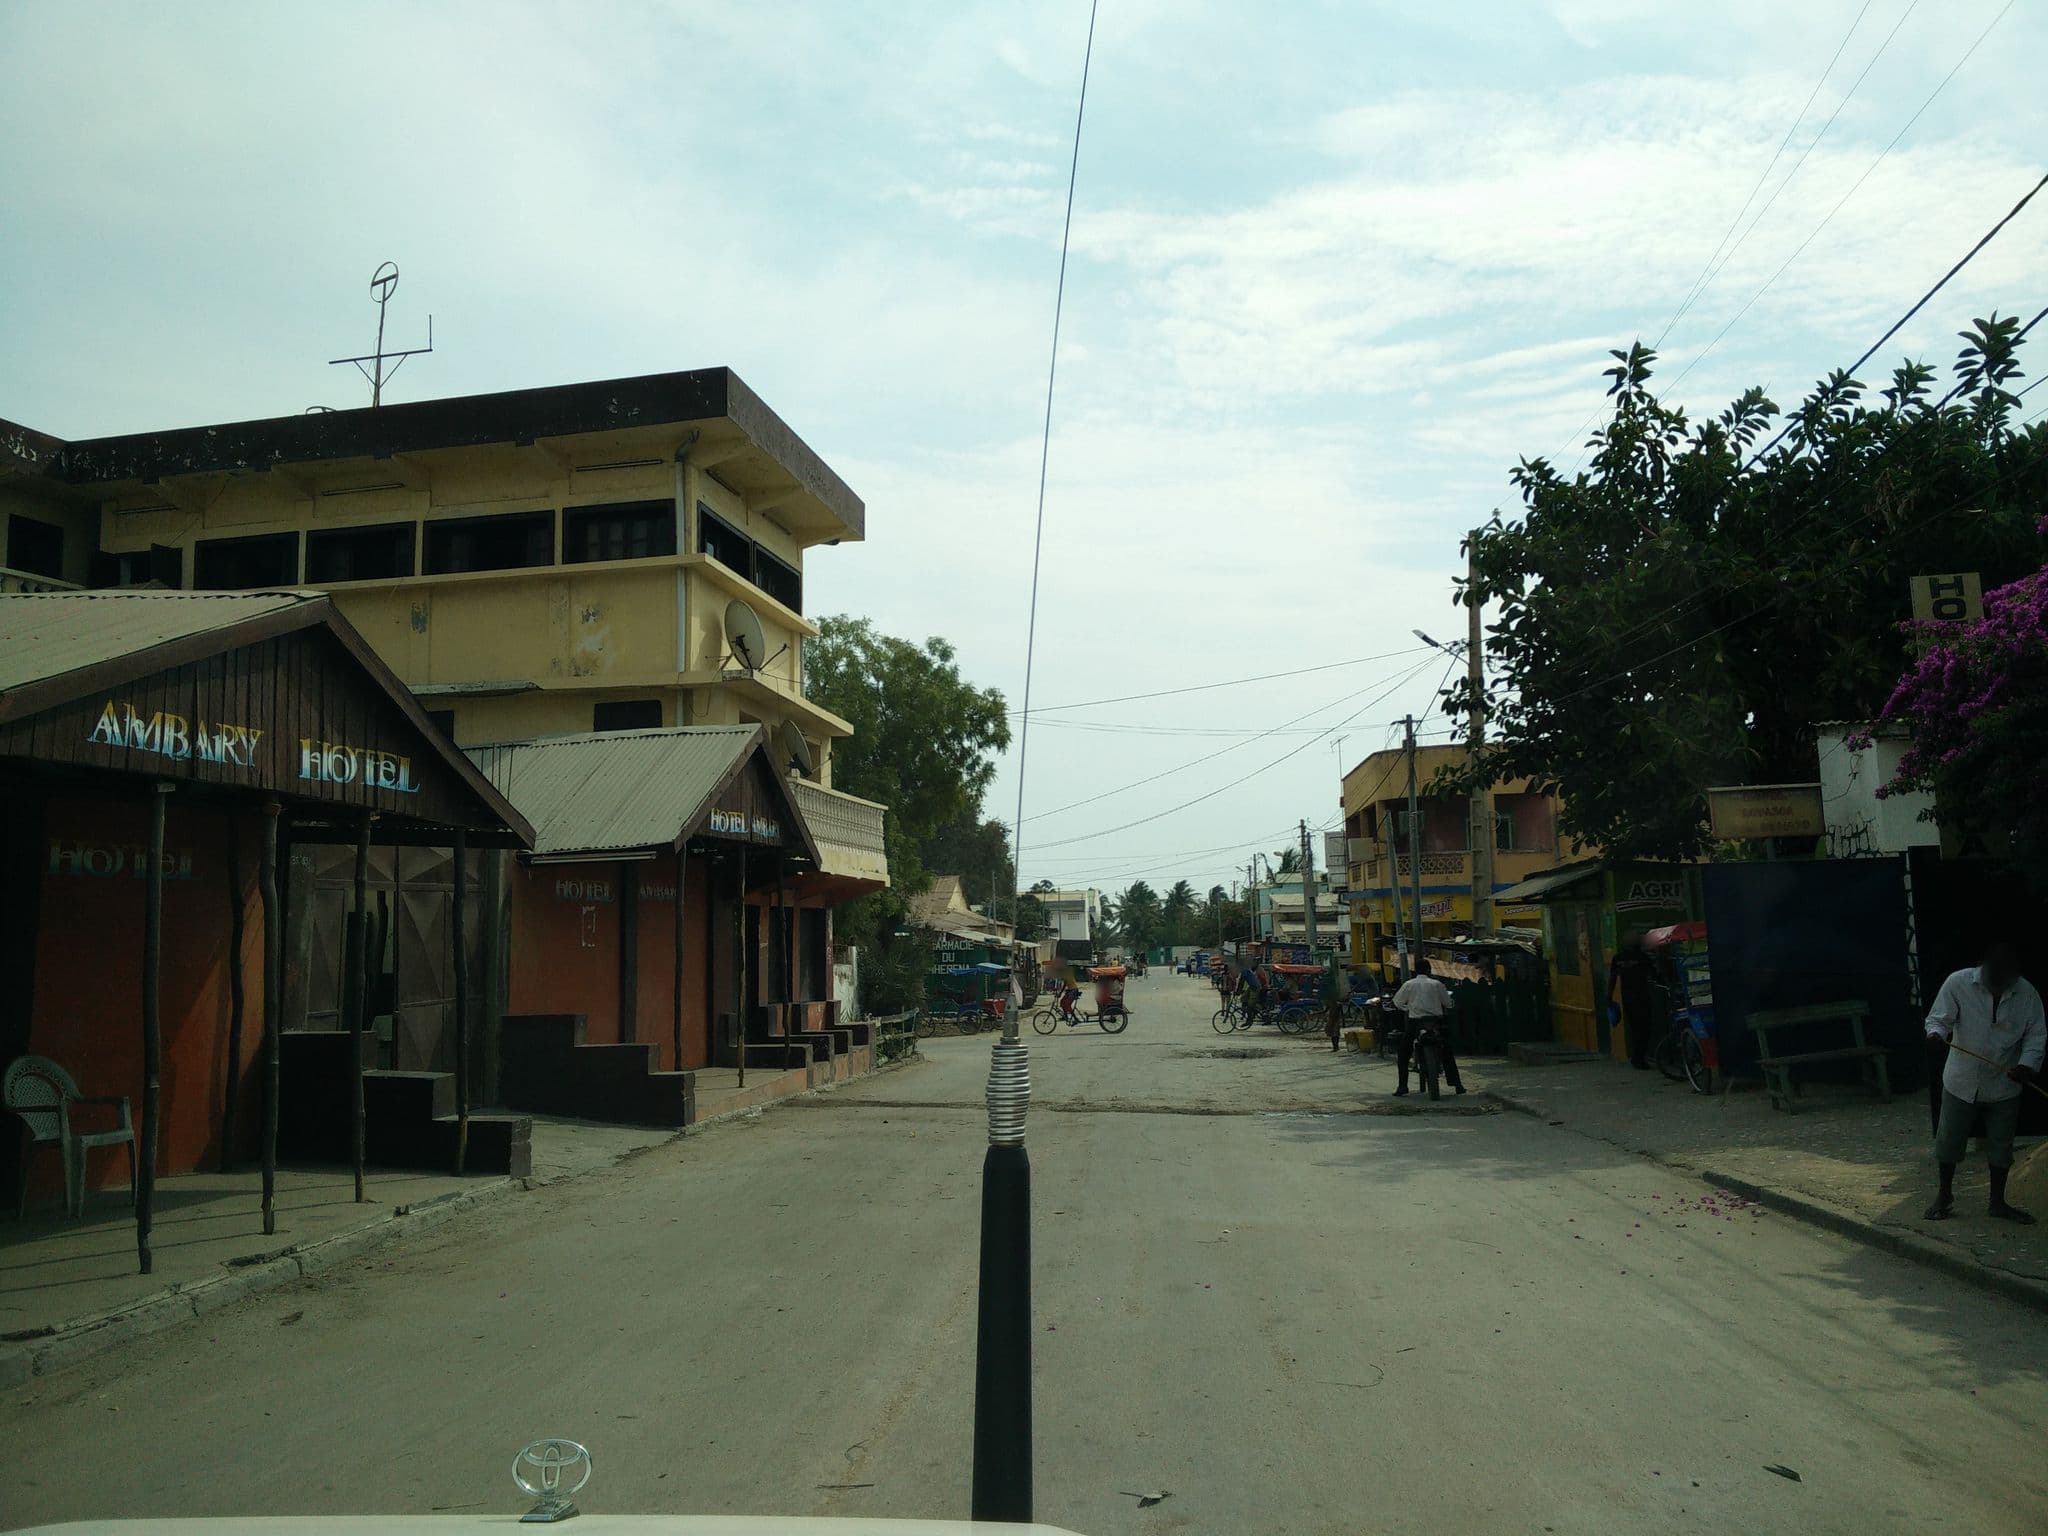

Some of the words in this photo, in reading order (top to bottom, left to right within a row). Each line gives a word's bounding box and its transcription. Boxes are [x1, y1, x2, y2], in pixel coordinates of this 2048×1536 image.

[86, 699, 264, 768] AMBARY
[299, 737, 421, 793] HOTEL
[710, 808, 748, 833] HOTEL
[1628, 881, 1684, 899] AGRI
[941, 952, 955, 963] DU
